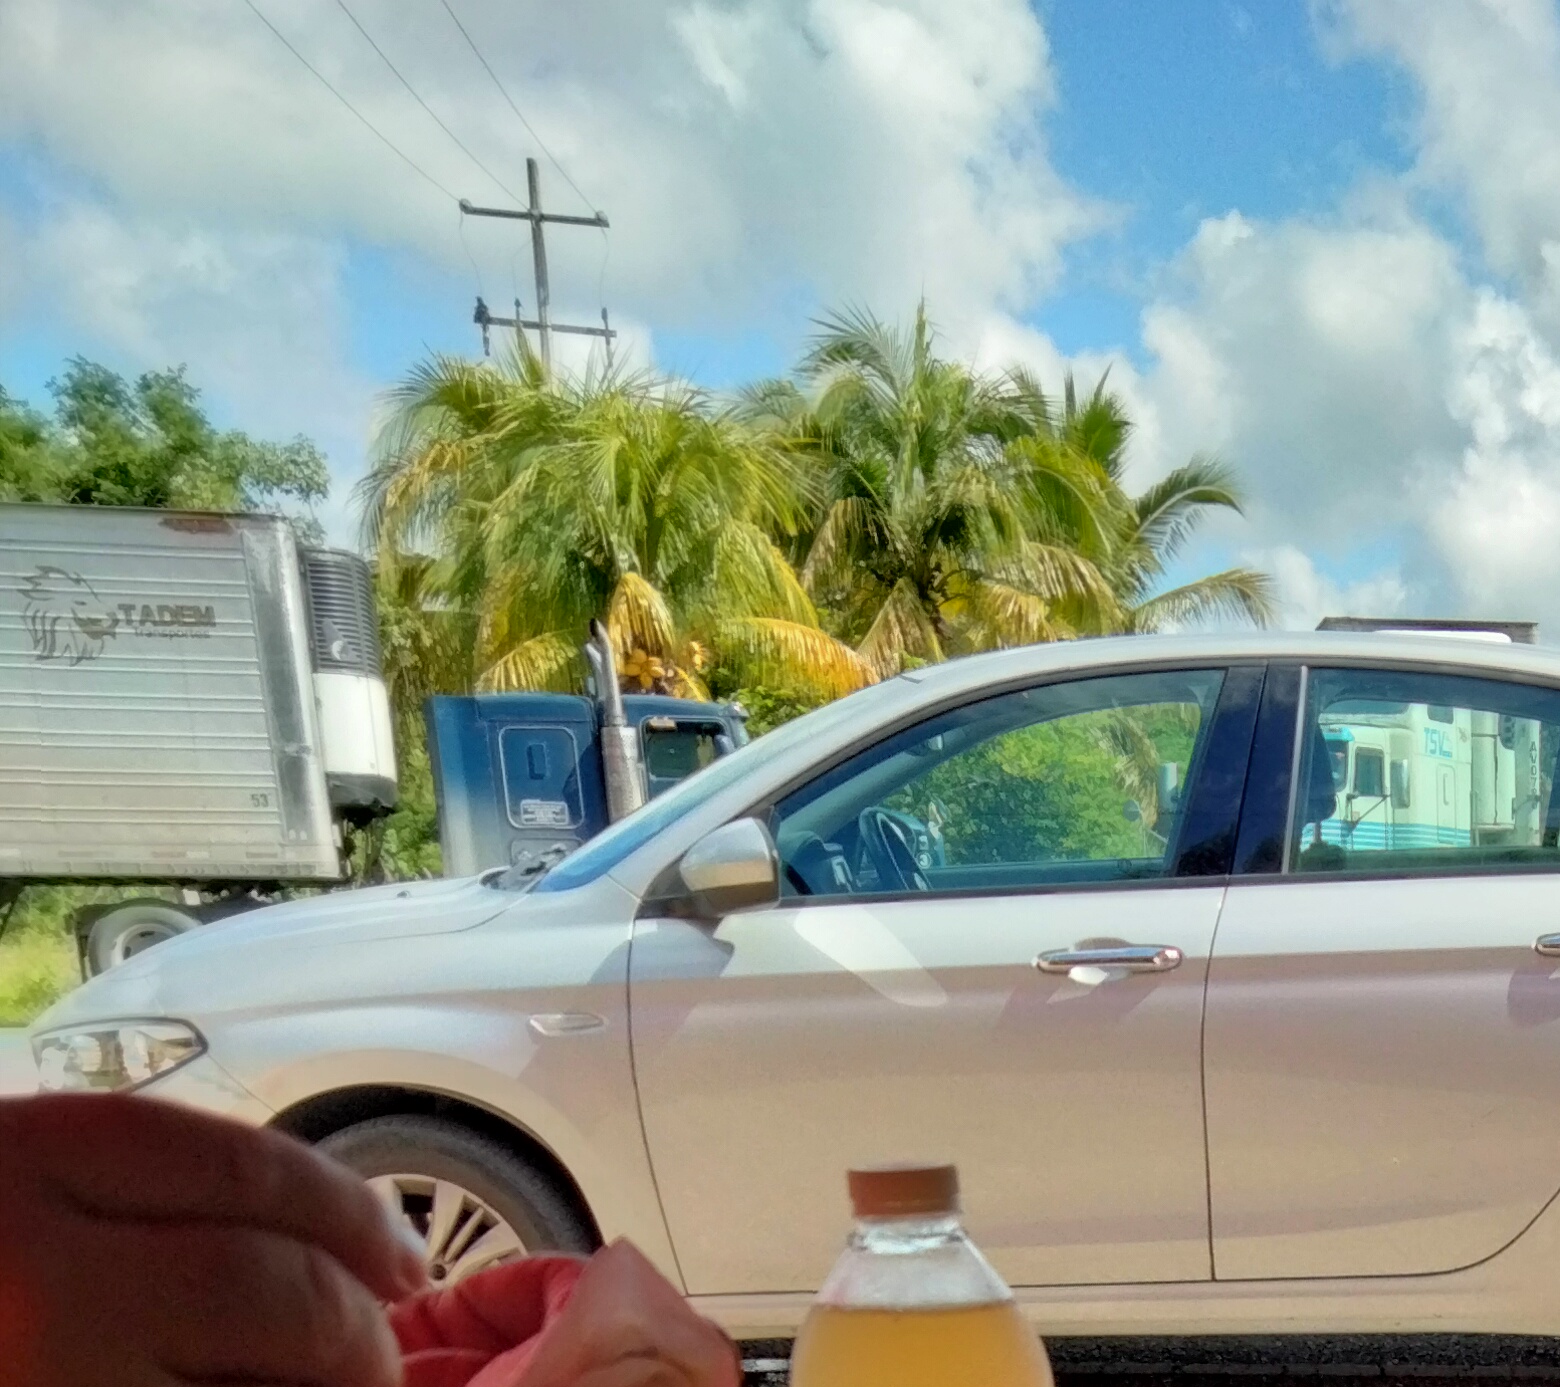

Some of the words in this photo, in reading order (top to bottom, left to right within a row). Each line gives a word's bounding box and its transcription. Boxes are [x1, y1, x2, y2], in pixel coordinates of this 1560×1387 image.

[117, 604, 216, 628] TADEM
[1424, 727, 1448, 756] TSV
[251, 794, 269, 808] 53
